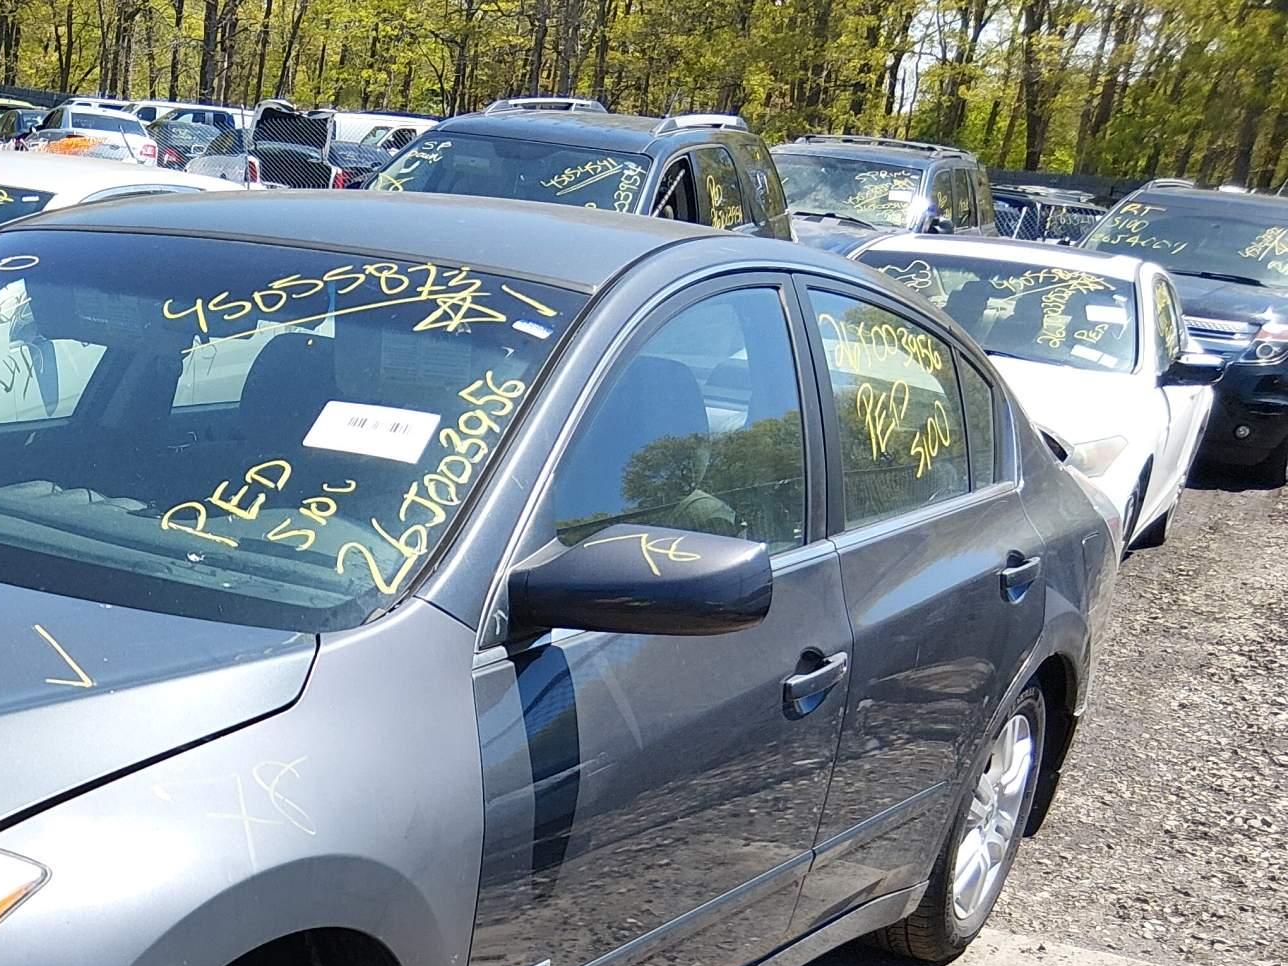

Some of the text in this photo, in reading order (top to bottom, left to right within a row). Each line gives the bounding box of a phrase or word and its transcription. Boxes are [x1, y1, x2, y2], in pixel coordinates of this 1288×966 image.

[162, 262, 483, 334] 45055873
[856, 379, 910, 461] PED
[910, 400, 951, 478] S100
[161, 459, 292, 548] PED
